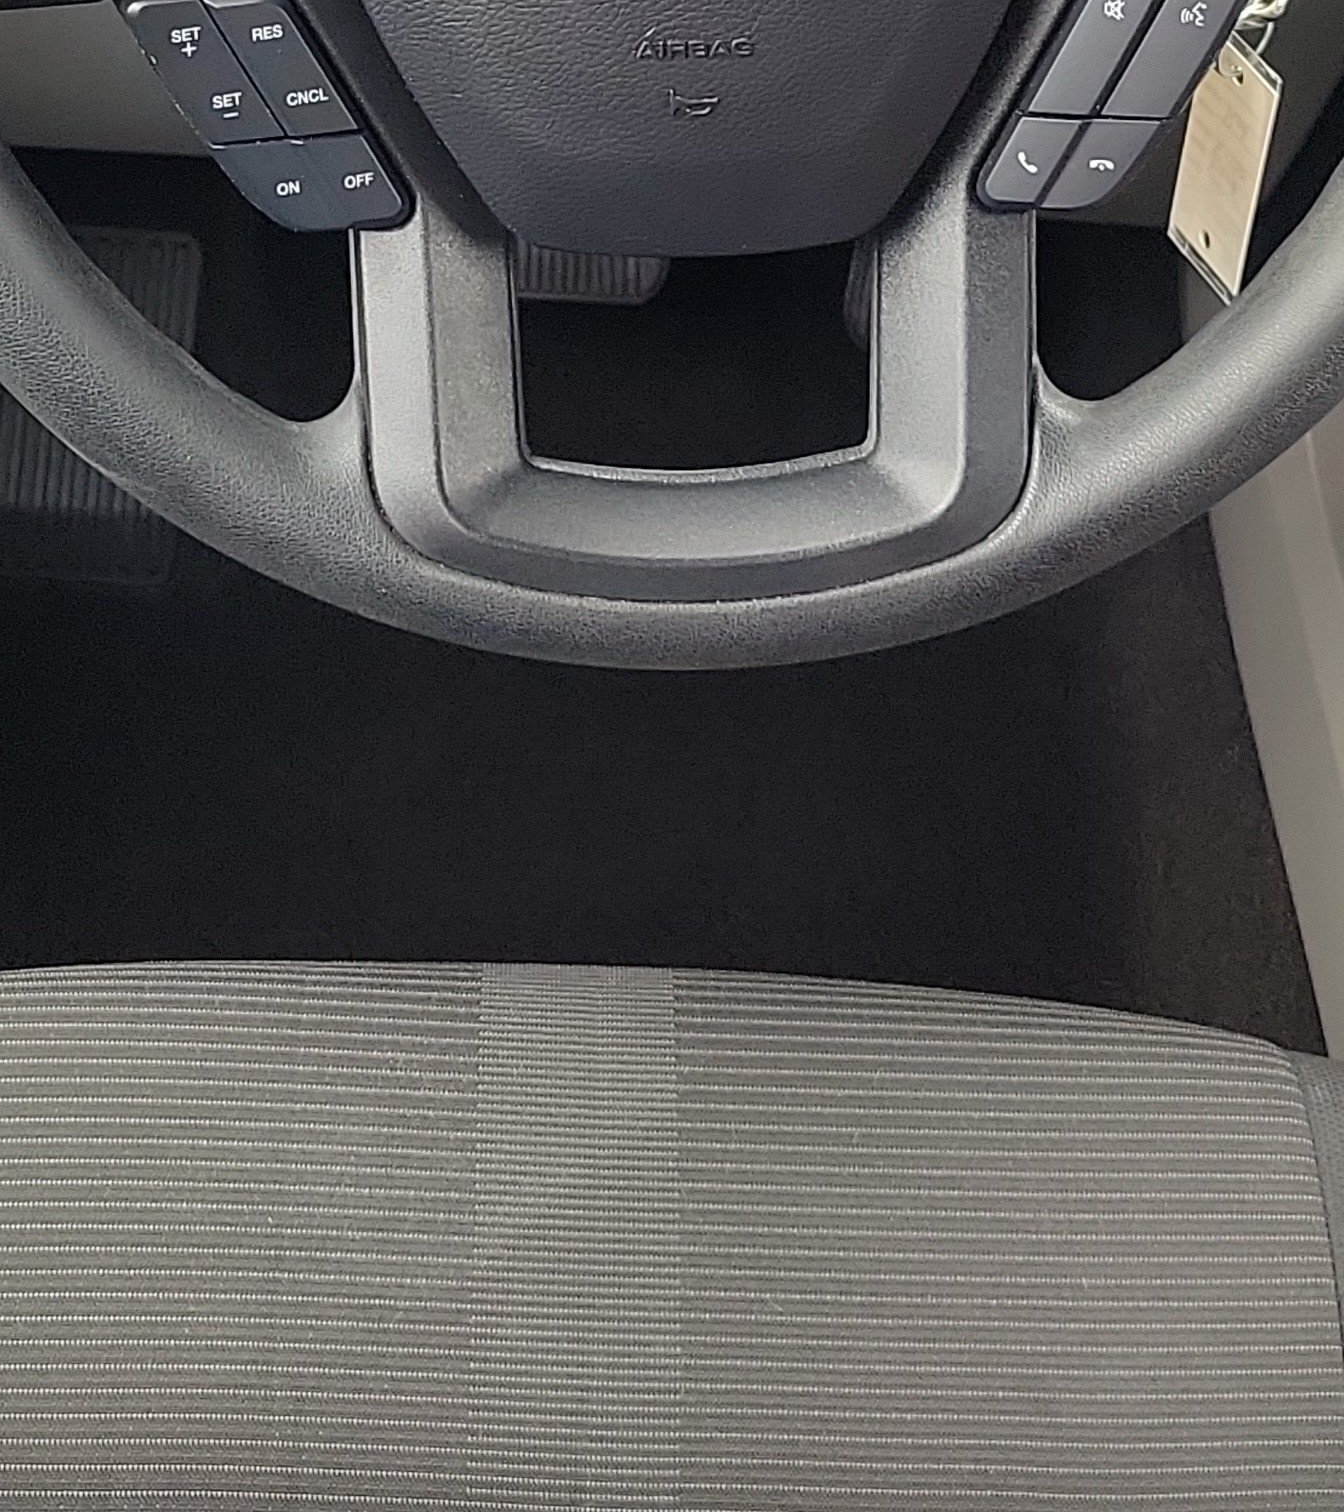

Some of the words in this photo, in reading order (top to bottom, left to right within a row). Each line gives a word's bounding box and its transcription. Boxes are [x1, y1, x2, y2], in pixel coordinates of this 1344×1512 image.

[170, 25, 202, 44] SET
[251, 24, 284, 43] RES
[634, 34, 754, 60] AIRBAG
[212, 92, 243, 110] SET
[286, 89, 330, 107] CNCL
[275, 179, 302, 197] ON
[343, 172, 376, 191] OFF
